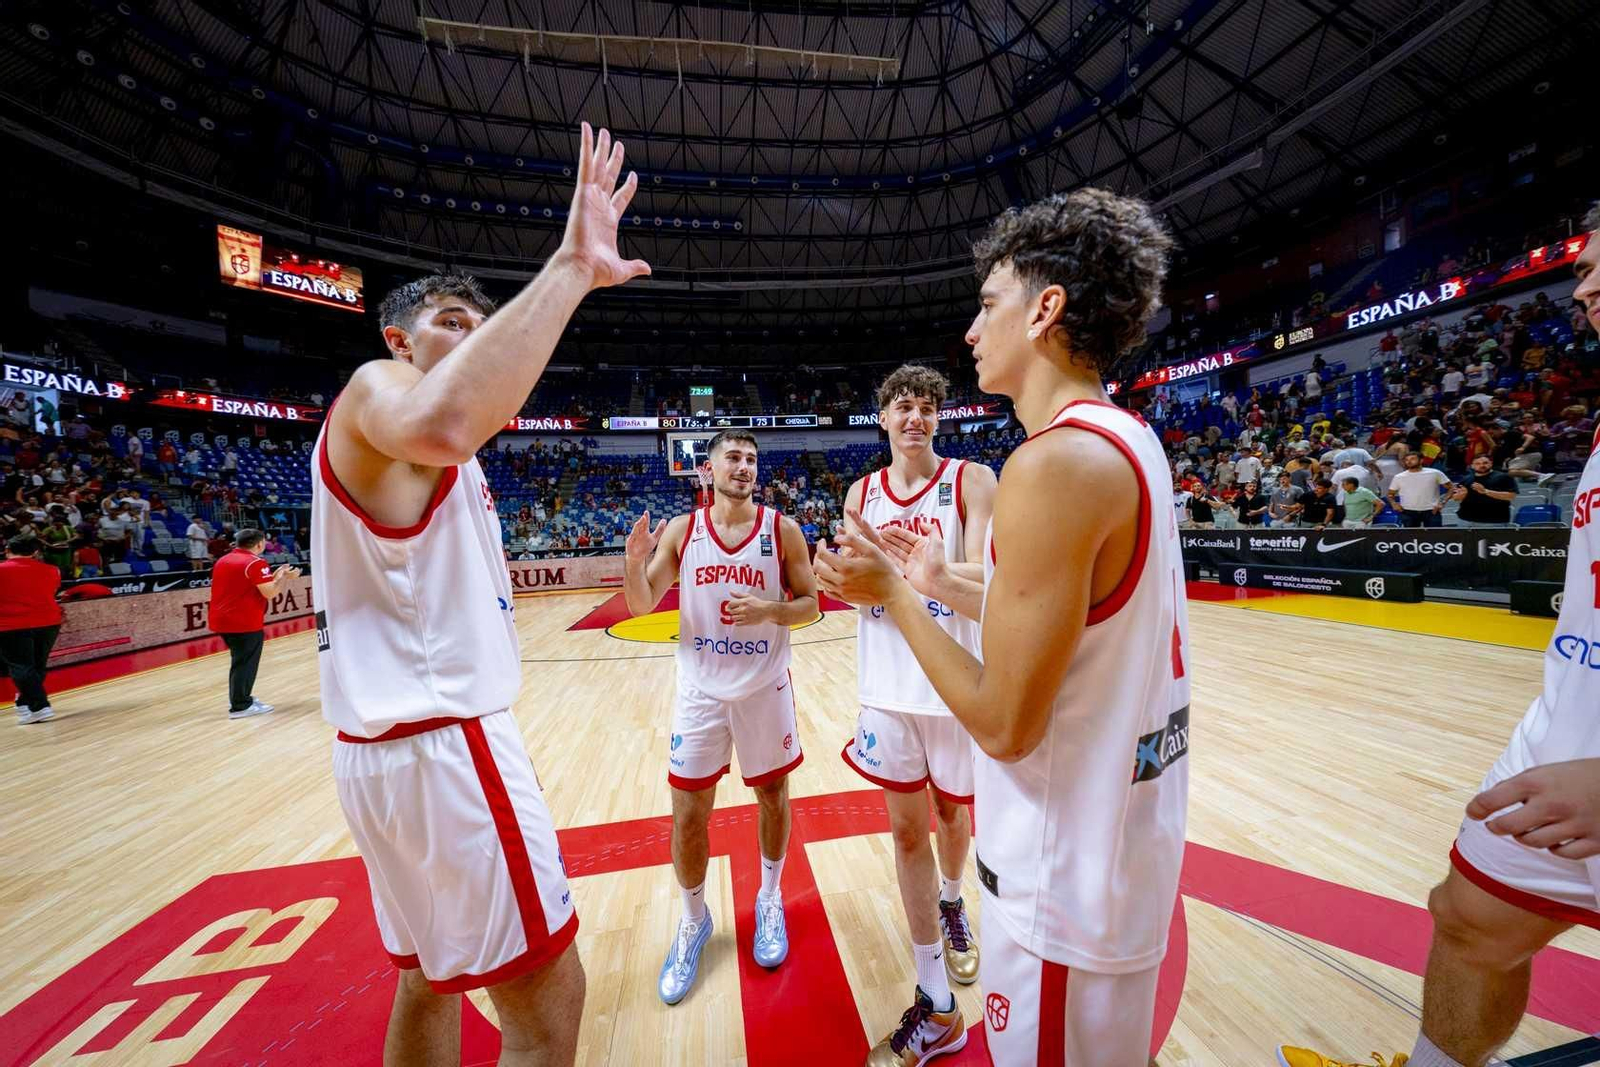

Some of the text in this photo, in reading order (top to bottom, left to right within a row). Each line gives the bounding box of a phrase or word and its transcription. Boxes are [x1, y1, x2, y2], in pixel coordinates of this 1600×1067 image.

[271, 270, 357, 303] ESPAÑA B
[1347, 282, 1457, 330] ESPAÑA B
[1168, 352, 1234, 381] ESPAÑA B
[3, 364, 121, 399] ESPAÑA B
[212, 399, 298, 420] ESPAÑA B
[977, 406, 985, 416] B
[517, 417, 573, 431] ESPAÑA B
[662, 419, 676, 428] 80
[849, 414, 881, 426] ESPAÑ
[1197, 538, 1235, 549] CaixaBank
[1376, 539, 1463, 556] endesa
[1515, 543, 1569, 558] Caixa
[695, 564, 766, 591] ESPAÑA
[1272, 580, 1282, 588] DE
[111, 582, 146, 594] erife!
[694, 636, 768, 655] endesa
[1159, 724, 1189, 763] Caix
